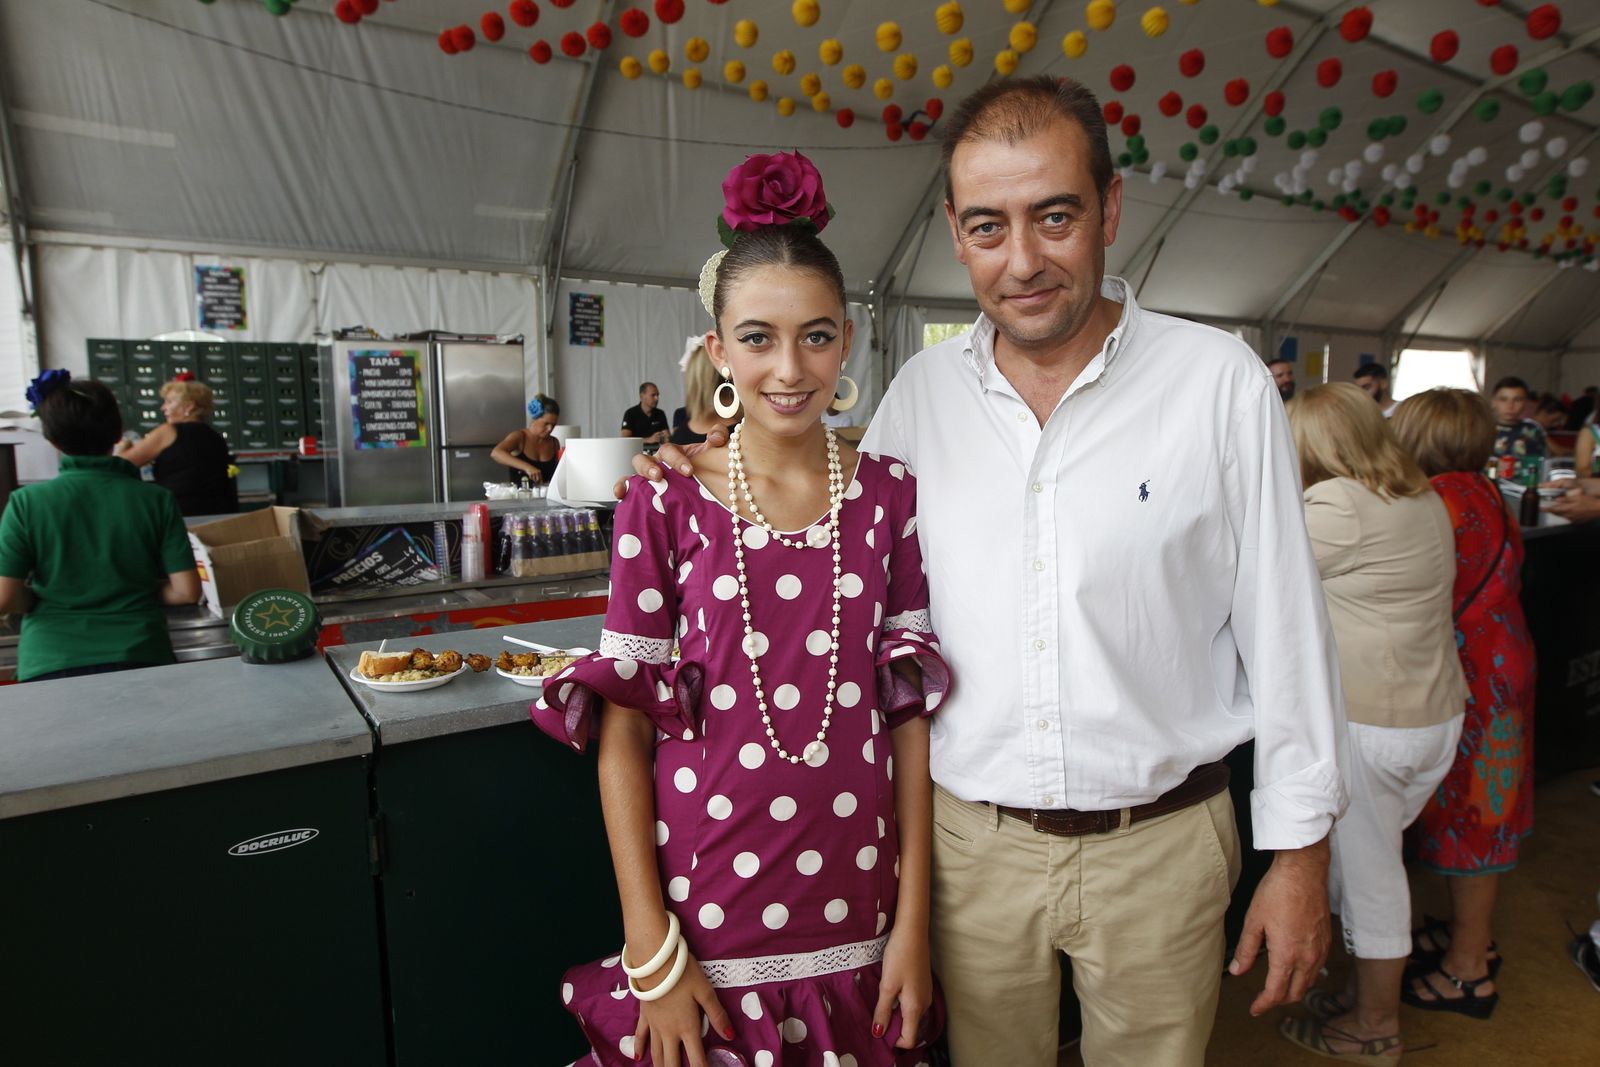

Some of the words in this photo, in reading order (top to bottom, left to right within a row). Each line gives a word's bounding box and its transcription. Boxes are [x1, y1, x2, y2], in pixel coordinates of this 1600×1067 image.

[368, 357, 401, 367] TAPAS
[331, 551, 385, 584] PRECIOS
[252, 599, 264, 608] DE
[264, 595, 302, 608] LEVANTE
[244, 607, 266, 637] ESTRELLA
[289, 608, 306, 632] MURCIA
[268, 630, 289, 638] 1963
[237, 830, 311, 854] DOCRILUC
